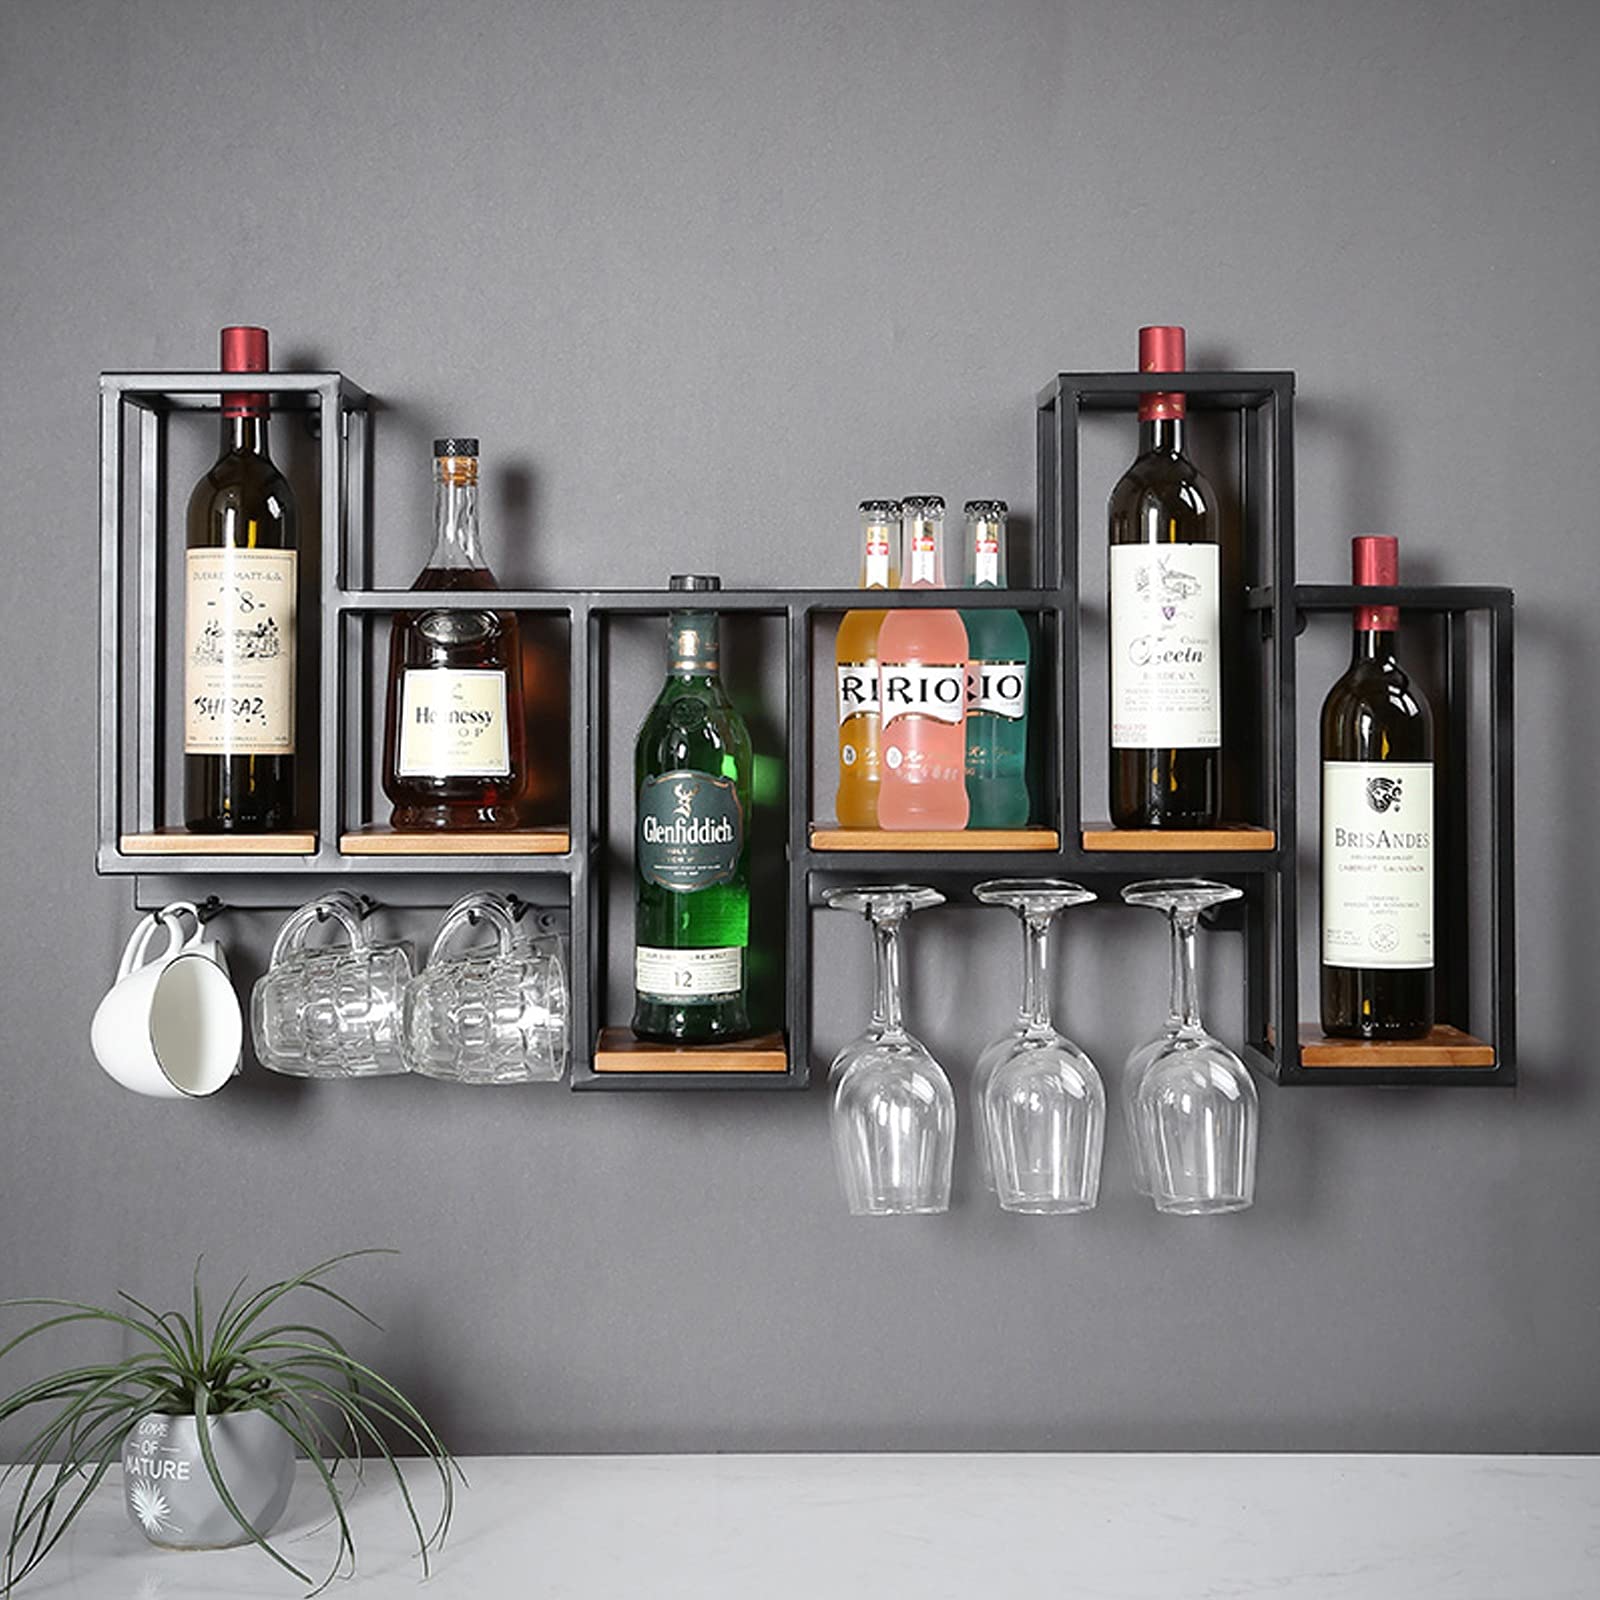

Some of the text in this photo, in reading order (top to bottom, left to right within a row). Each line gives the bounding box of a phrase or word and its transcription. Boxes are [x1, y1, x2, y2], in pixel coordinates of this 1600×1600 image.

[841, 676, 879, 704] RI
[886, 676, 960, 704] RIO
[643, 815, 733, 846] Glenfiddich
[674, 970, 693, 988] 12
[141, 1440, 159, 1456] OF
[124, 1455, 190, 1480] NATURE
